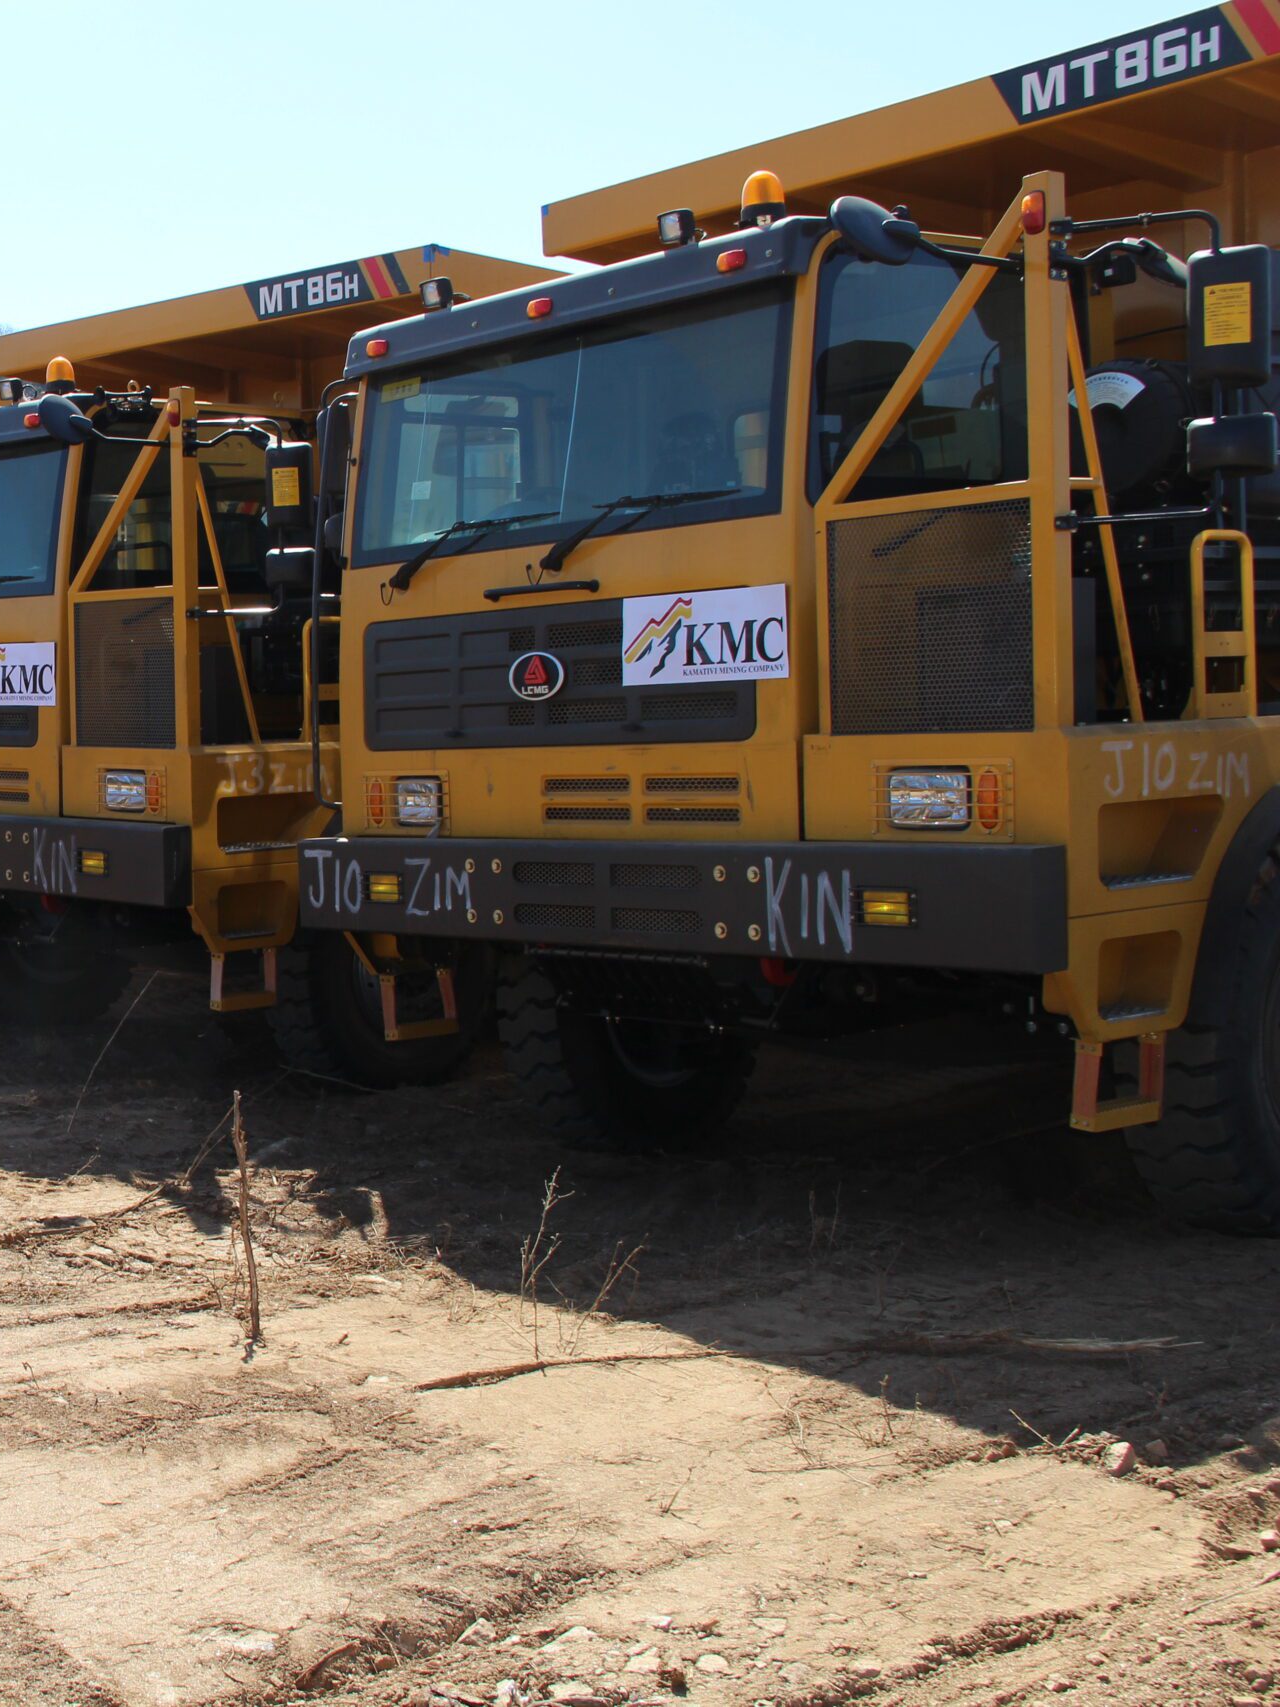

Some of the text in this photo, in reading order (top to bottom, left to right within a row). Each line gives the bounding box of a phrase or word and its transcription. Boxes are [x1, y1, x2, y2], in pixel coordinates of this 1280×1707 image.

[1021, 25, 1220, 116] MT86H
[258, 271, 359, 315] MT86H
[682, 616, 785, 667] KMC
[0, 664, 54, 695] KMC
[521, 685, 549, 695] LCMG
[719, 665, 747, 675] MINING
[748, 663, 785, 673] COMPANY
[216, 753, 333, 797] J3 ZIM
[1100, 740, 1251, 798] J10 ZIM
[33, 827, 78, 894] KIN
[303, 848, 854, 957] J10 ZIM KIN
